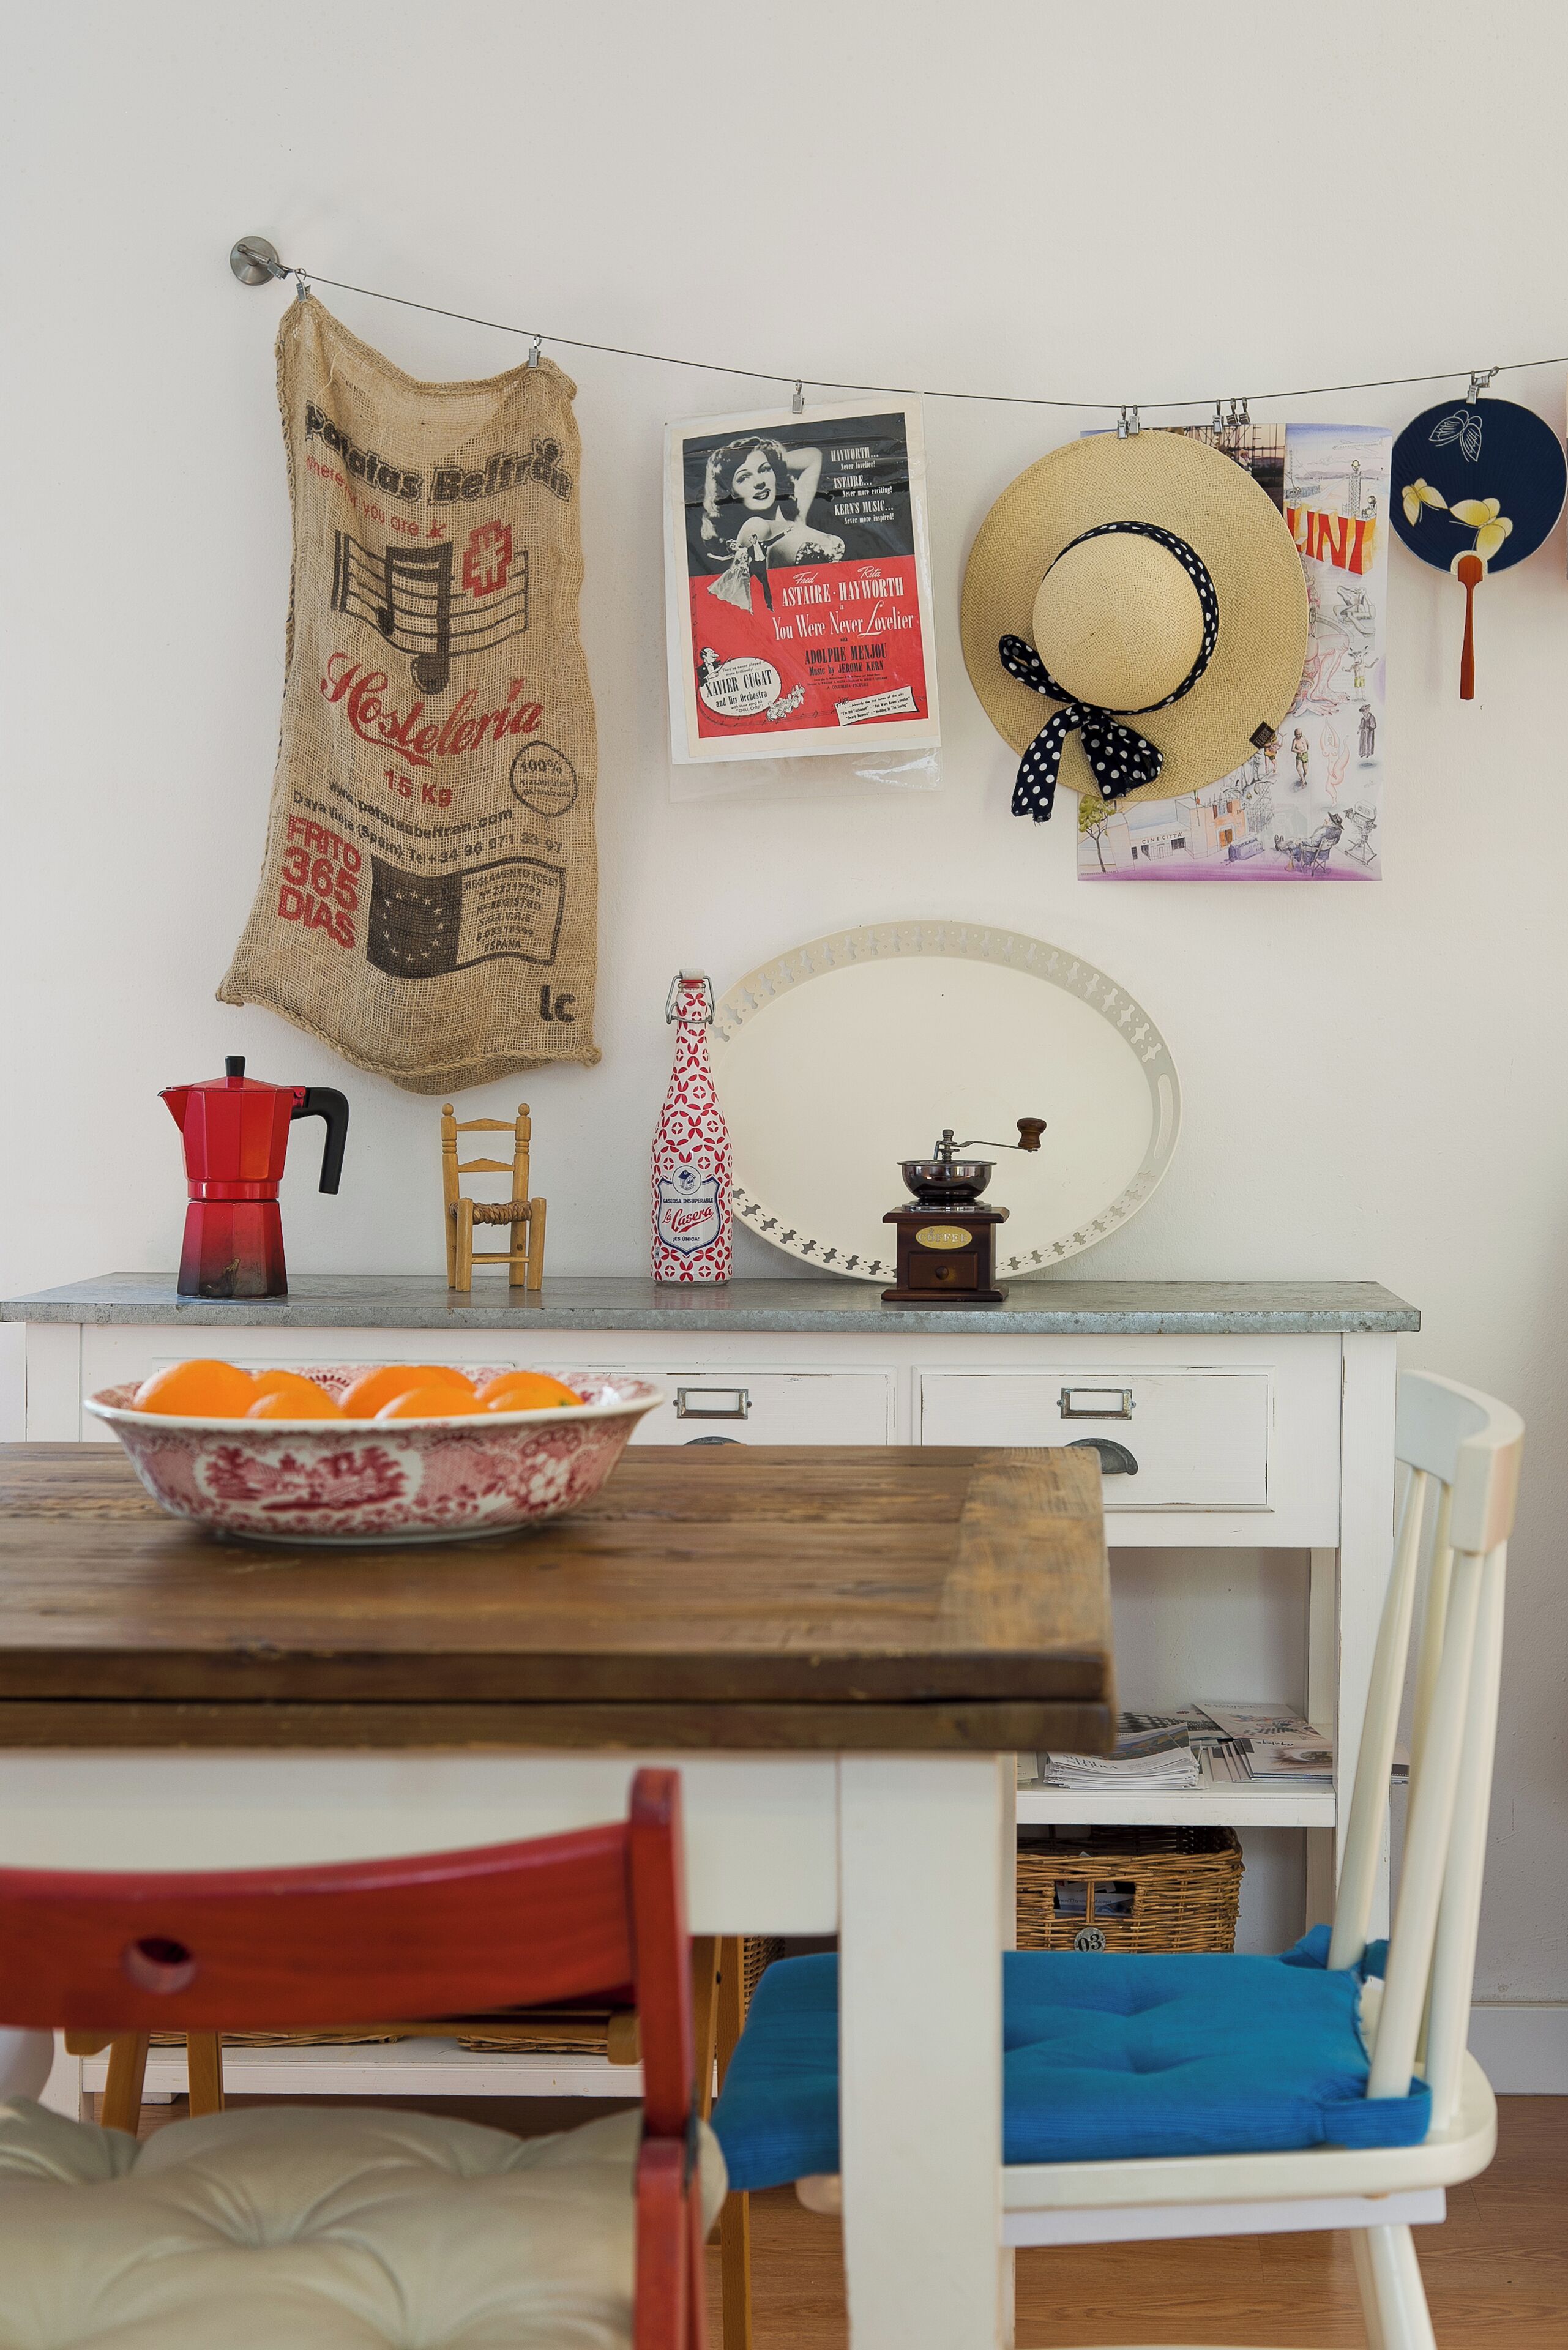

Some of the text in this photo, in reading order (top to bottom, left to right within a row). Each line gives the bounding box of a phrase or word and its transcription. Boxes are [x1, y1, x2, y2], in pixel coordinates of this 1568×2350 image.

[305, 400, 423, 504] Patatas
[856, 460, 876, 469] lovelier!
[872, 485, 892, 495] exciting!
[362, 500, 385, 523] you
[390, 516, 420, 537] are
[834, 502, 860, 516] KERN'S
[873, 513, 894, 523] inspired!
[793, 571, 818, 585] Fred
[857, 565, 882, 580] Rita
[782, 577, 905, 607] ASTAIRE HAYWORTH
[772, 600, 914, 640] You Were Never Lovelier
[805, 643, 887, 665] ADOLPHE MENJOU
[809, 660, 884, 676] Music by JEROME KERN
[705, 670, 772, 698] XAVIER CUGAT
[716, 690, 768, 707] and His Orchestra
[520, 759, 562, 774] 100%
[384, 770, 452, 807] 15 Kg
[286, 814, 361, 873] FRITO
[464, 841, 483, 857] 96
[282, 846, 358, 912] 365
[278, 885, 356, 949] DIAS
[662, 1206, 714, 1233] La Casera
[919, 1233, 968, 1243] COFFEE
[1078, 1934, 1102, 1953] 03
